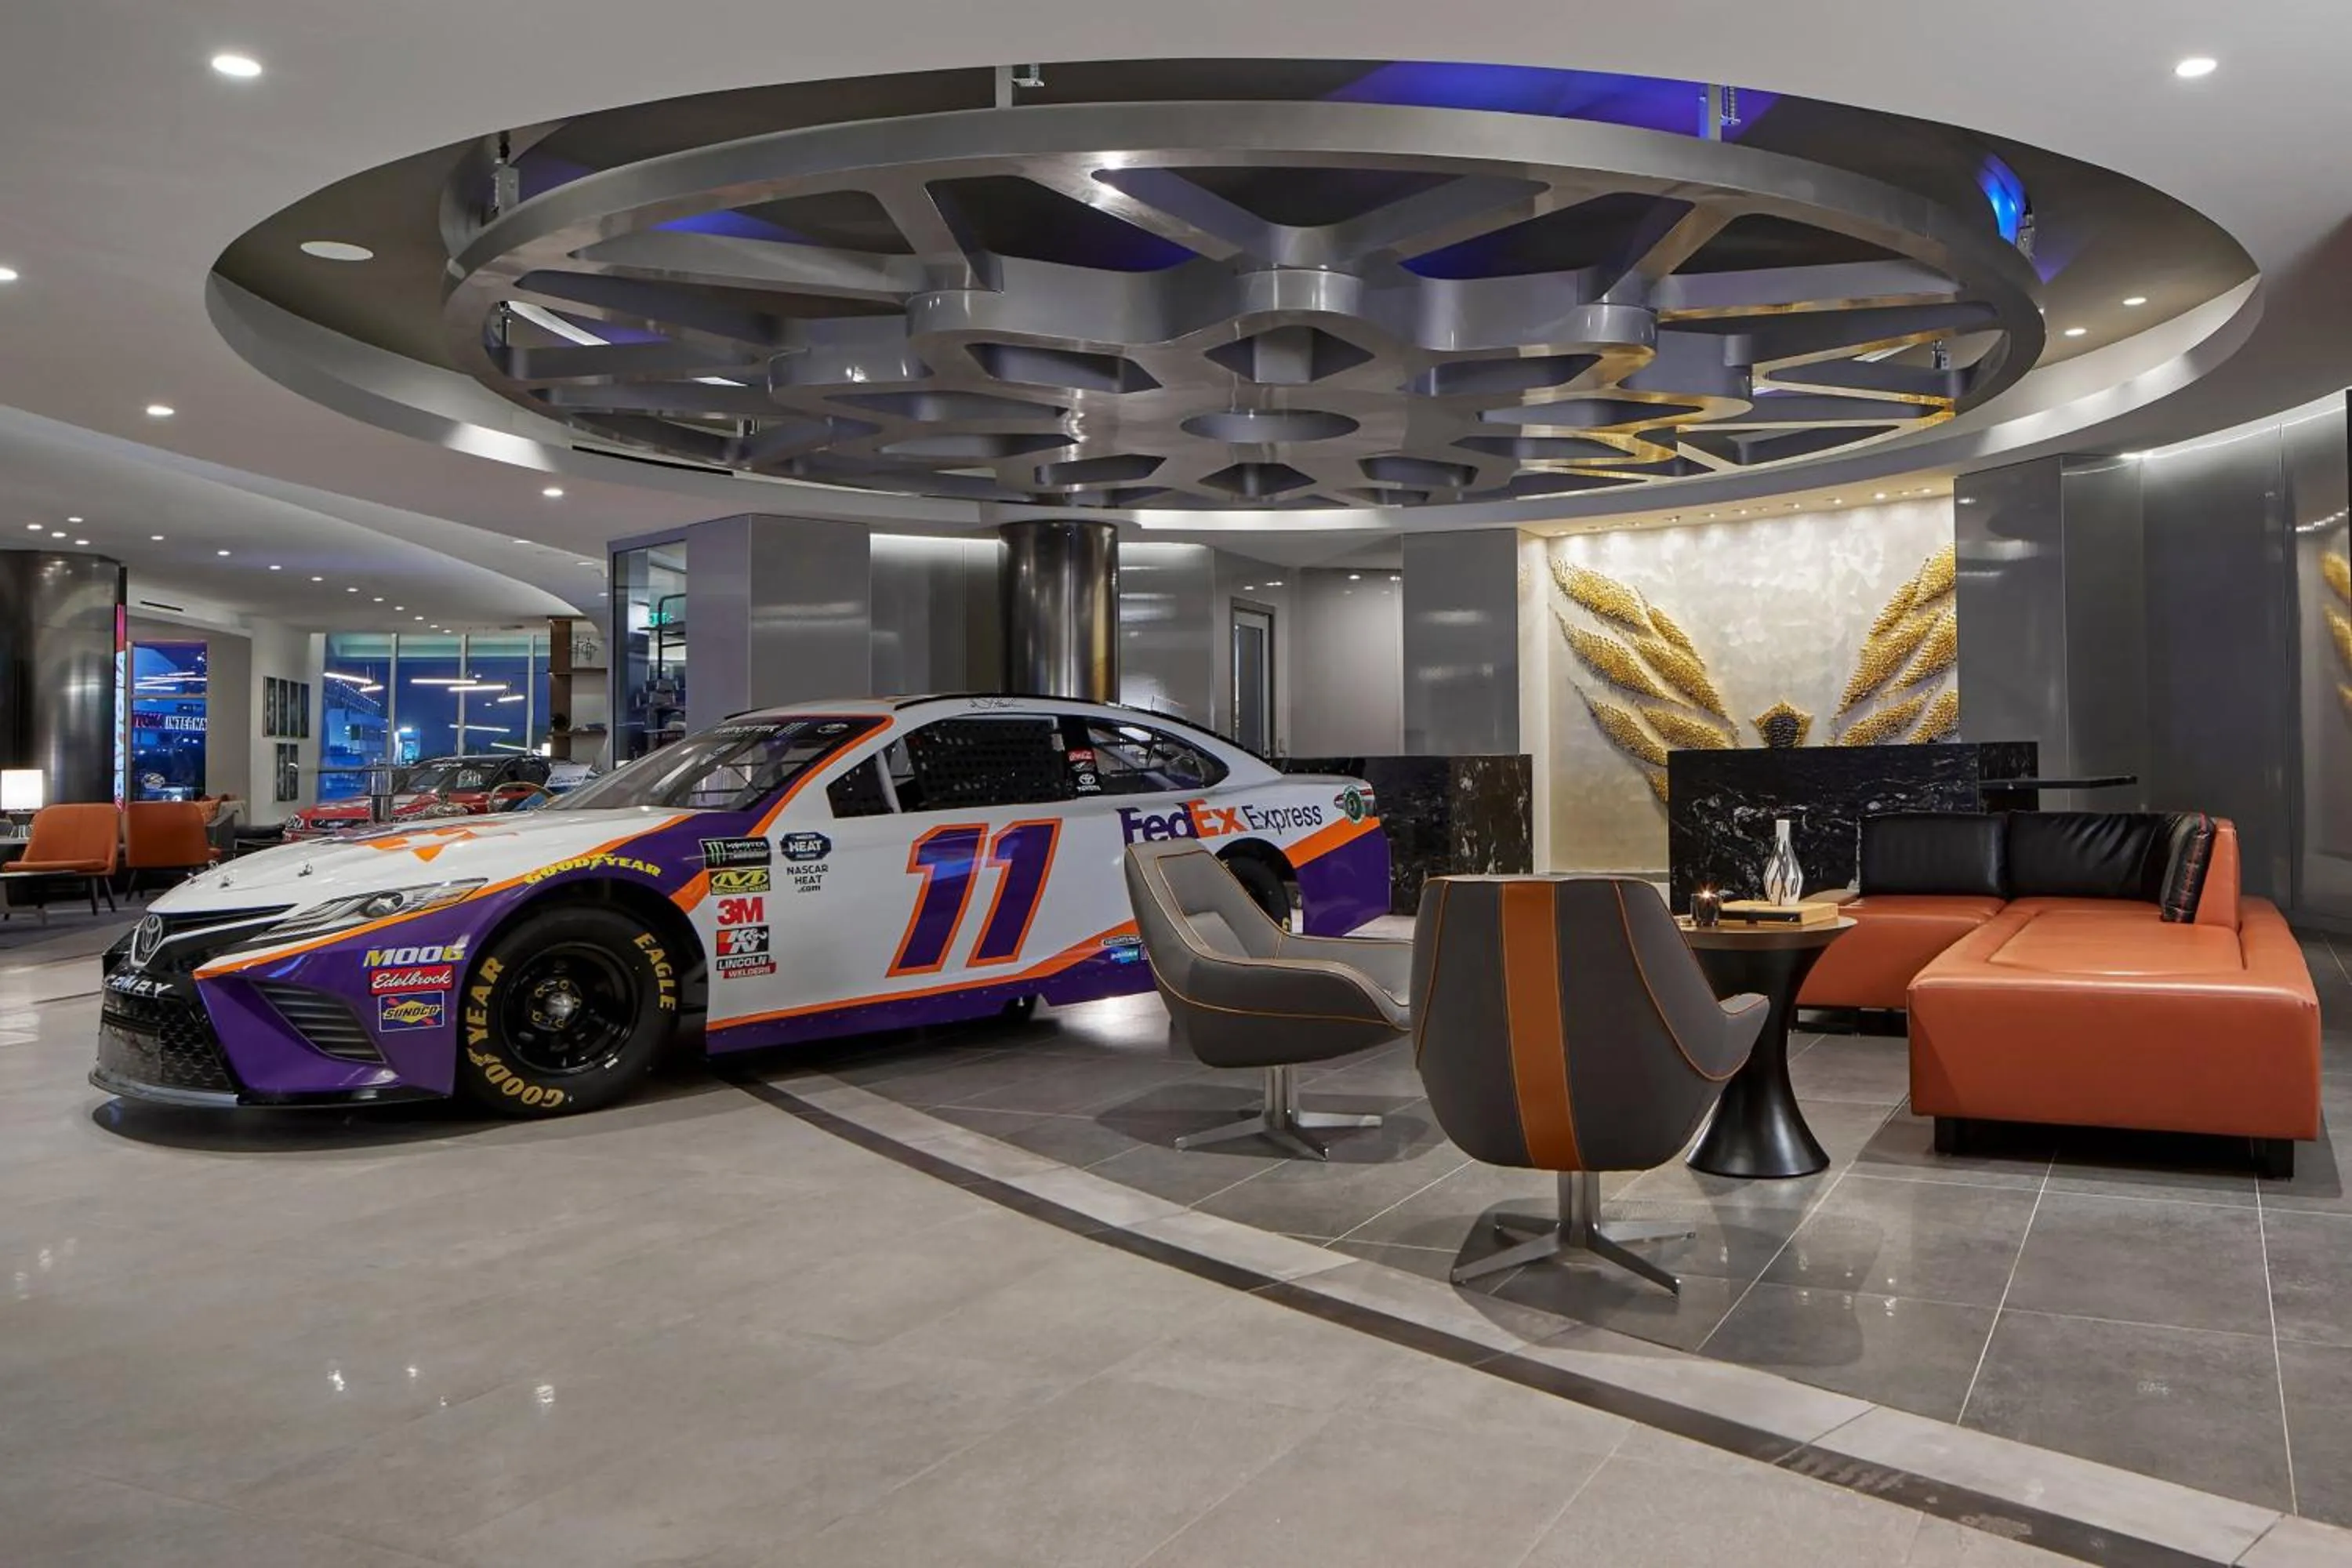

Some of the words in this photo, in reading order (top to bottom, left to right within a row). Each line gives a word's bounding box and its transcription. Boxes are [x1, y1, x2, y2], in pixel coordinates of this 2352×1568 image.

[1116, 798, 1250, 847] FedEx
[1241, 804, 1323, 835] Express
[788, 840, 822, 852] HEAT
[524, 853, 662, 884] GOODYEAR
[786, 864, 829, 876] NASCAR
[794, 874, 822, 884] HEAT
[884, 817, 1063, 978] 11
[717, 896, 764, 925] 3M
[633, 932, 676, 1011] EAGLE
[718, 956, 768, 969] LINCOLN
[371, 971, 452, 989] Edelbrock
[383, 1004, 442, 1020] SUNOCO
[465, 956, 565, 1109] GOODYEAR
